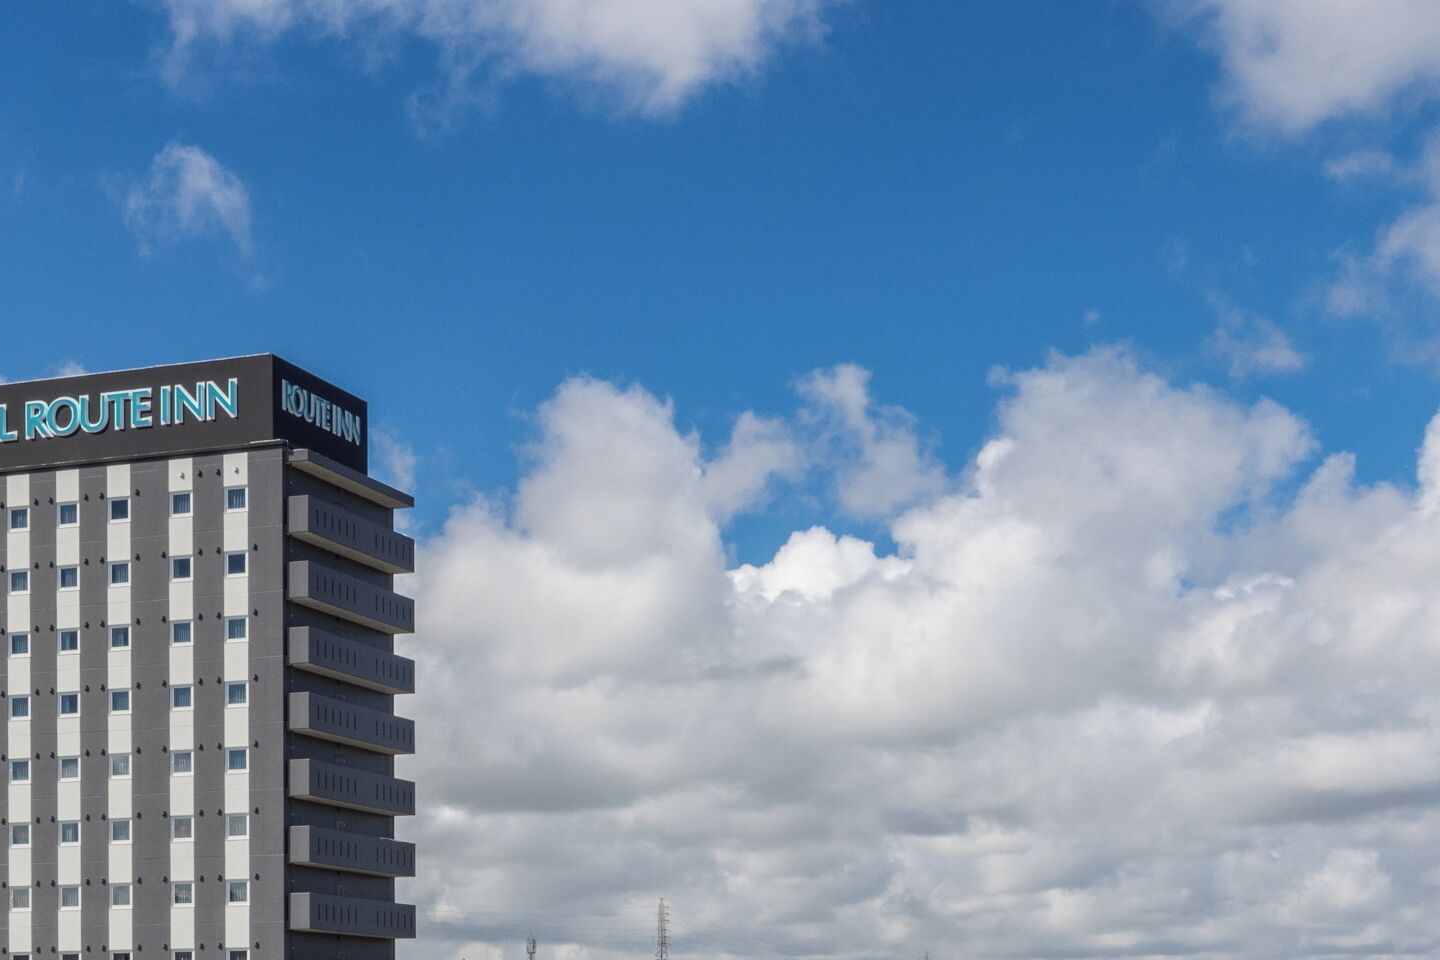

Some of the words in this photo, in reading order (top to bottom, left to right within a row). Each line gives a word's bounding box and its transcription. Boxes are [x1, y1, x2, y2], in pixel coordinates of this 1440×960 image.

[24, 387, 153, 440] ROUTE
[160, 377, 238, 426] INN
[282, 378, 331, 430] ROUTE
[332, 400, 361, 446] INN
